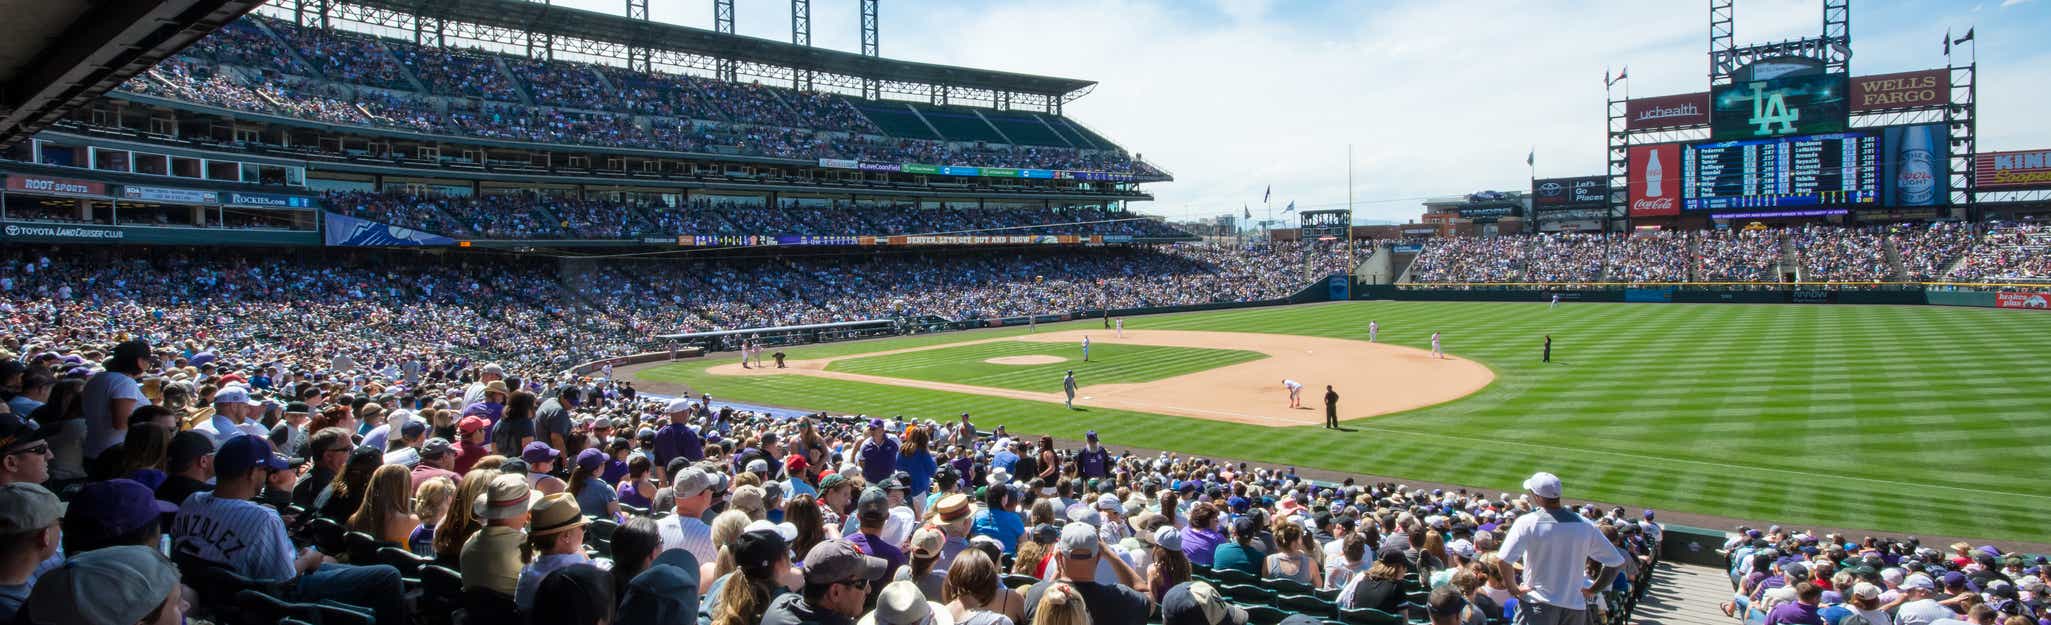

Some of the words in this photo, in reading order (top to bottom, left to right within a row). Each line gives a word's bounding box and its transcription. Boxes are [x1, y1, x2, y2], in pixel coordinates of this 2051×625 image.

[1861, 76, 1936, 93] WELLS
[1863, 90, 1936, 106] FARGO
[1640, 101, 1697, 120] uchealth
[1748, 82, 1799, 135] LA
[25, 178, 55, 190] ROOT
[55, 183, 88, 193] SPORTS
[1575, 180, 1596, 188] Let's
[1634, 197, 1675, 210] Coca-Cola
[21, 226, 55, 236] TOYOTA
[104, 230, 124, 239] CLUB
[992, 235, 1007, 245] AND
[1999, 293, 2028, 301] brakes
[2002, 300, 2022, 308] plus
[173, 511, 246, 560] ONZALEZ
